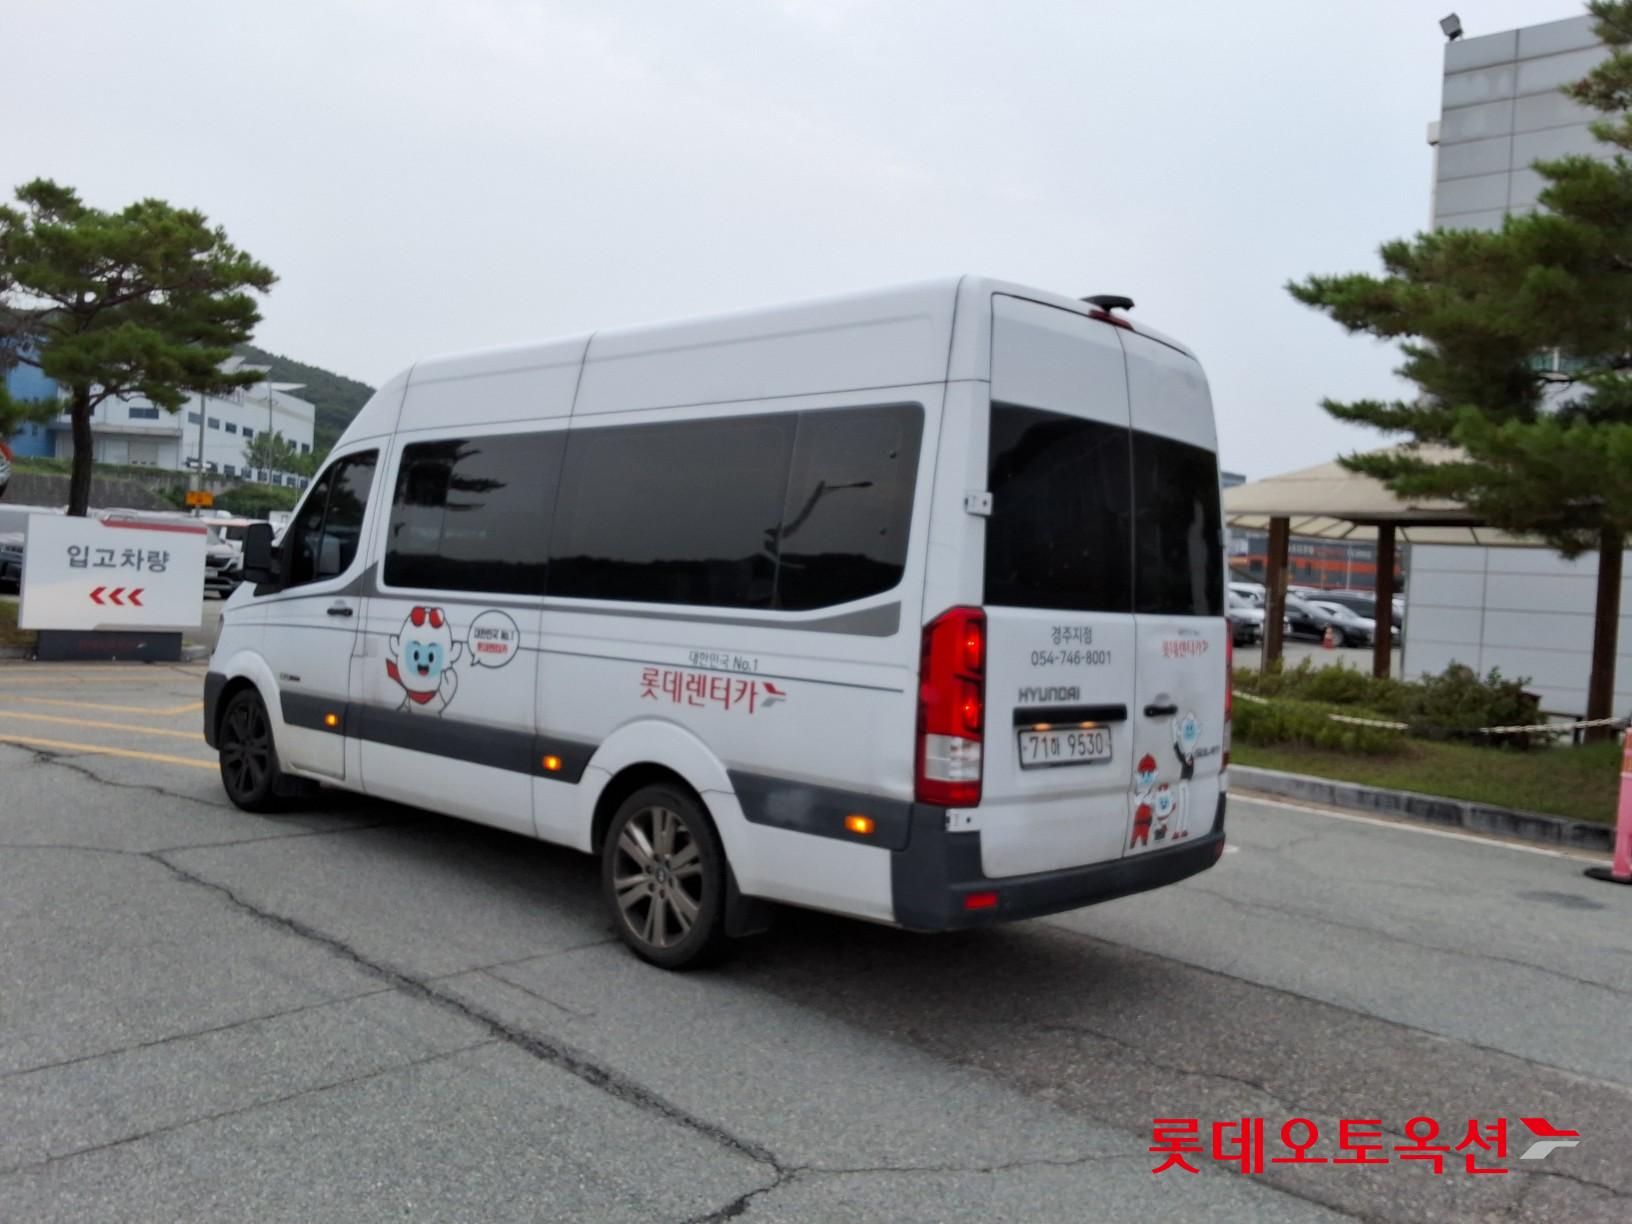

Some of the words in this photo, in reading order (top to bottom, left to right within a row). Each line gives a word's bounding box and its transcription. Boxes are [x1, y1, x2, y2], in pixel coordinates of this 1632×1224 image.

[67, 545, 170, 573] 입고차량
[1051, 626, 1092, 645] 경주지점
[689, 650, 729, 670] 대한민국
[733, 656, 759, 672] No.1
[1031, 650, 1112, 666] 054-746-8001
[640, 666, 758, 714] 롯데렌터카
[1018, 686, 1080, 702] HYUNDAI
[1067, 732, 1103, 756] 9530
